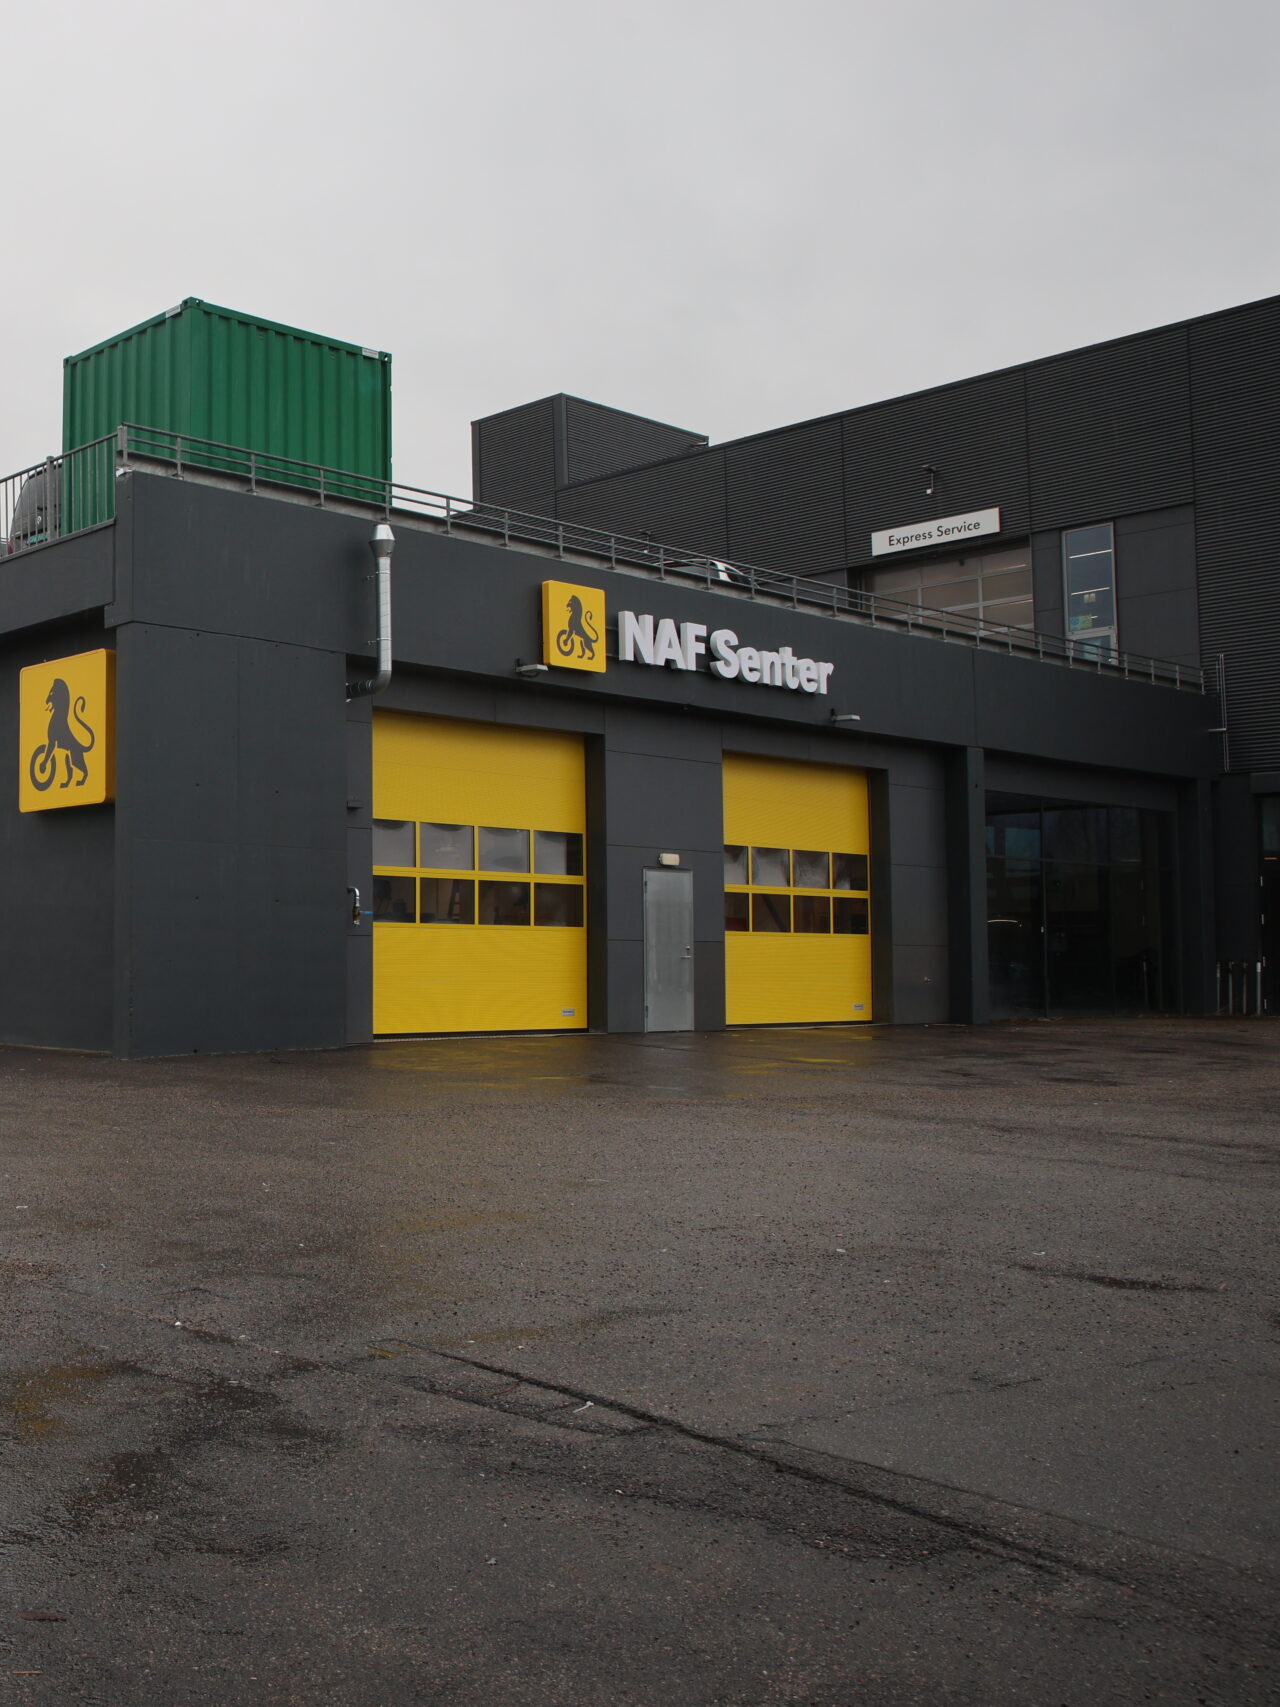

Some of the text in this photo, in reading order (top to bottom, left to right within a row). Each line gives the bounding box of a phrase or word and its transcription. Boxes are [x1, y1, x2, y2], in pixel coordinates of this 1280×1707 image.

[888, 520, 981, 548] Express Service
[618, 610, 834, 694] NAF Senter
